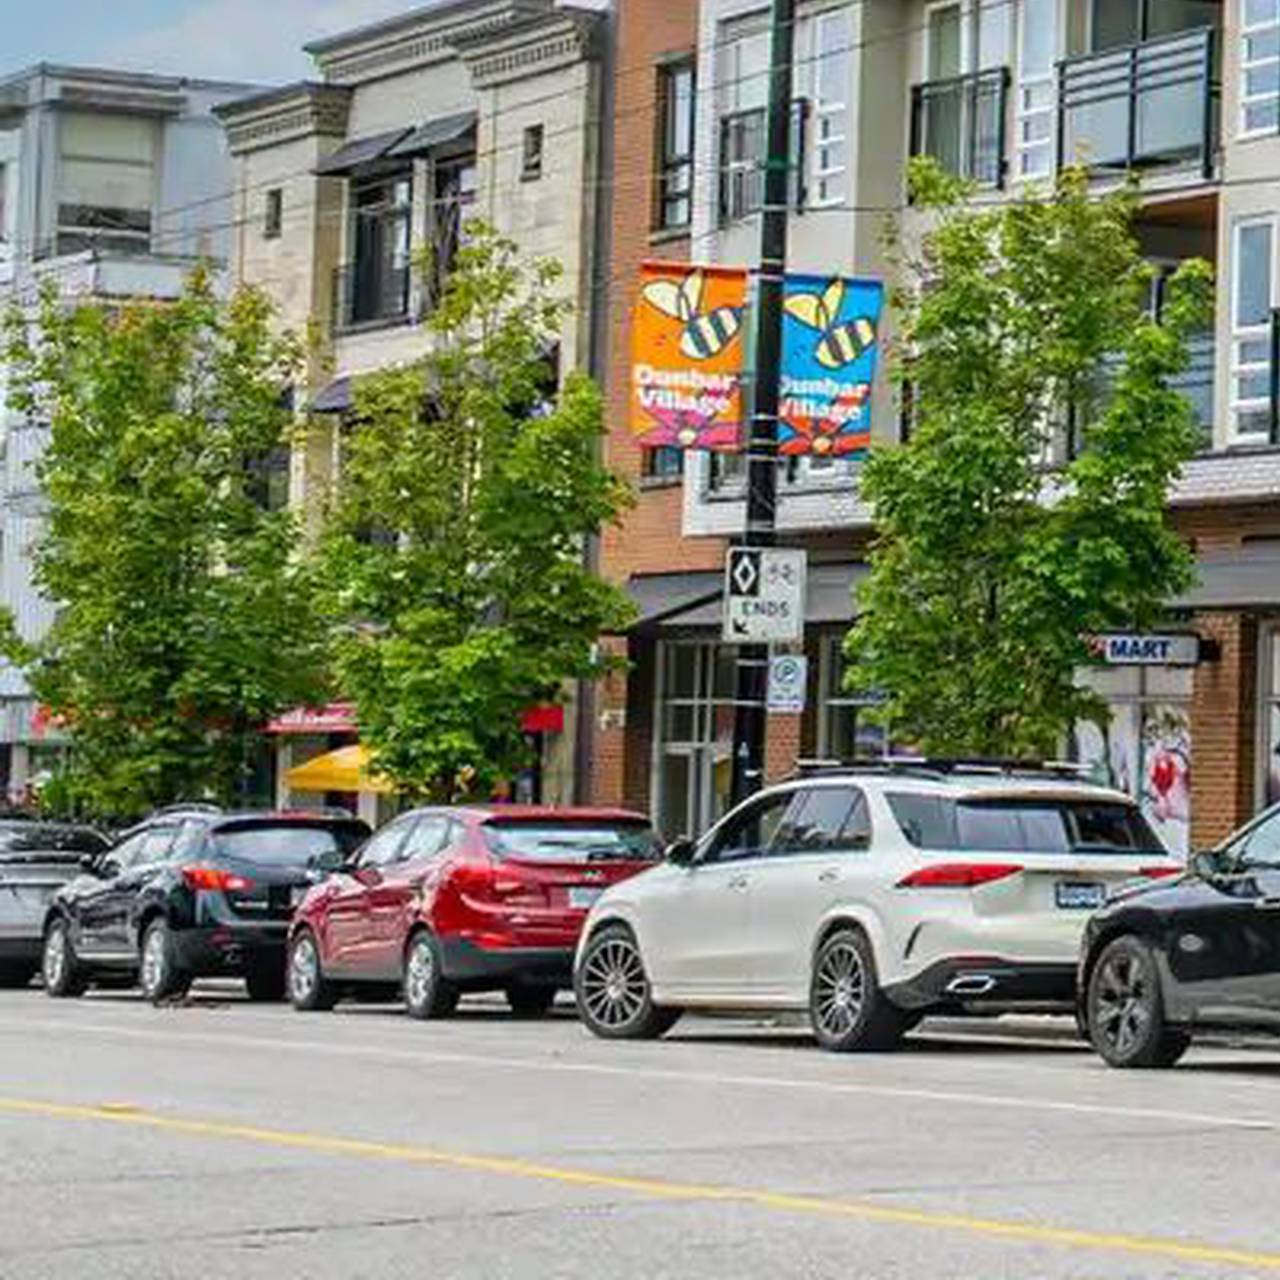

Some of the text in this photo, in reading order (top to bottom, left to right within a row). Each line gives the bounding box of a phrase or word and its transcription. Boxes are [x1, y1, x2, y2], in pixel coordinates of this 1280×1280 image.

[637, 388, 731, 416] Village
[741, 601, 790, 618] ENDS
[1110, 639, 1170, 658] MART
